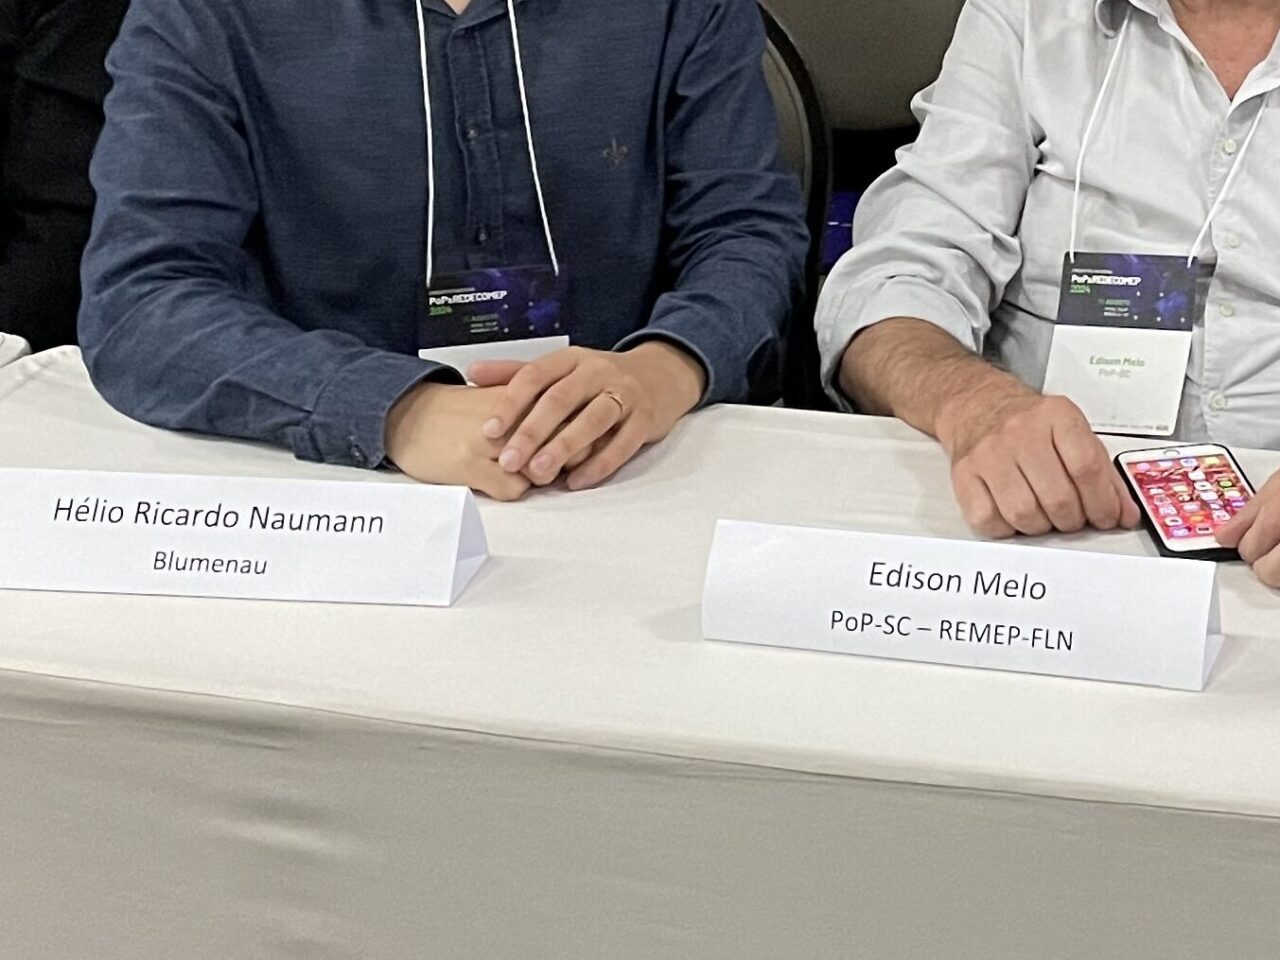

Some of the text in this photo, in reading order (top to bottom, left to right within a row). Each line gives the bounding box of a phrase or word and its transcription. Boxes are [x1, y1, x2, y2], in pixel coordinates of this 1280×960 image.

[53, 497, 384, 534] Hélio Ricardo Naumann
[153, 550, 268, 575] Blumenau
[868, 561, 1048, 601] Edison Melo
[830, 609, 912, 638] PoP-SC
[939, 619, 1074, 652] REMEP-FLN
